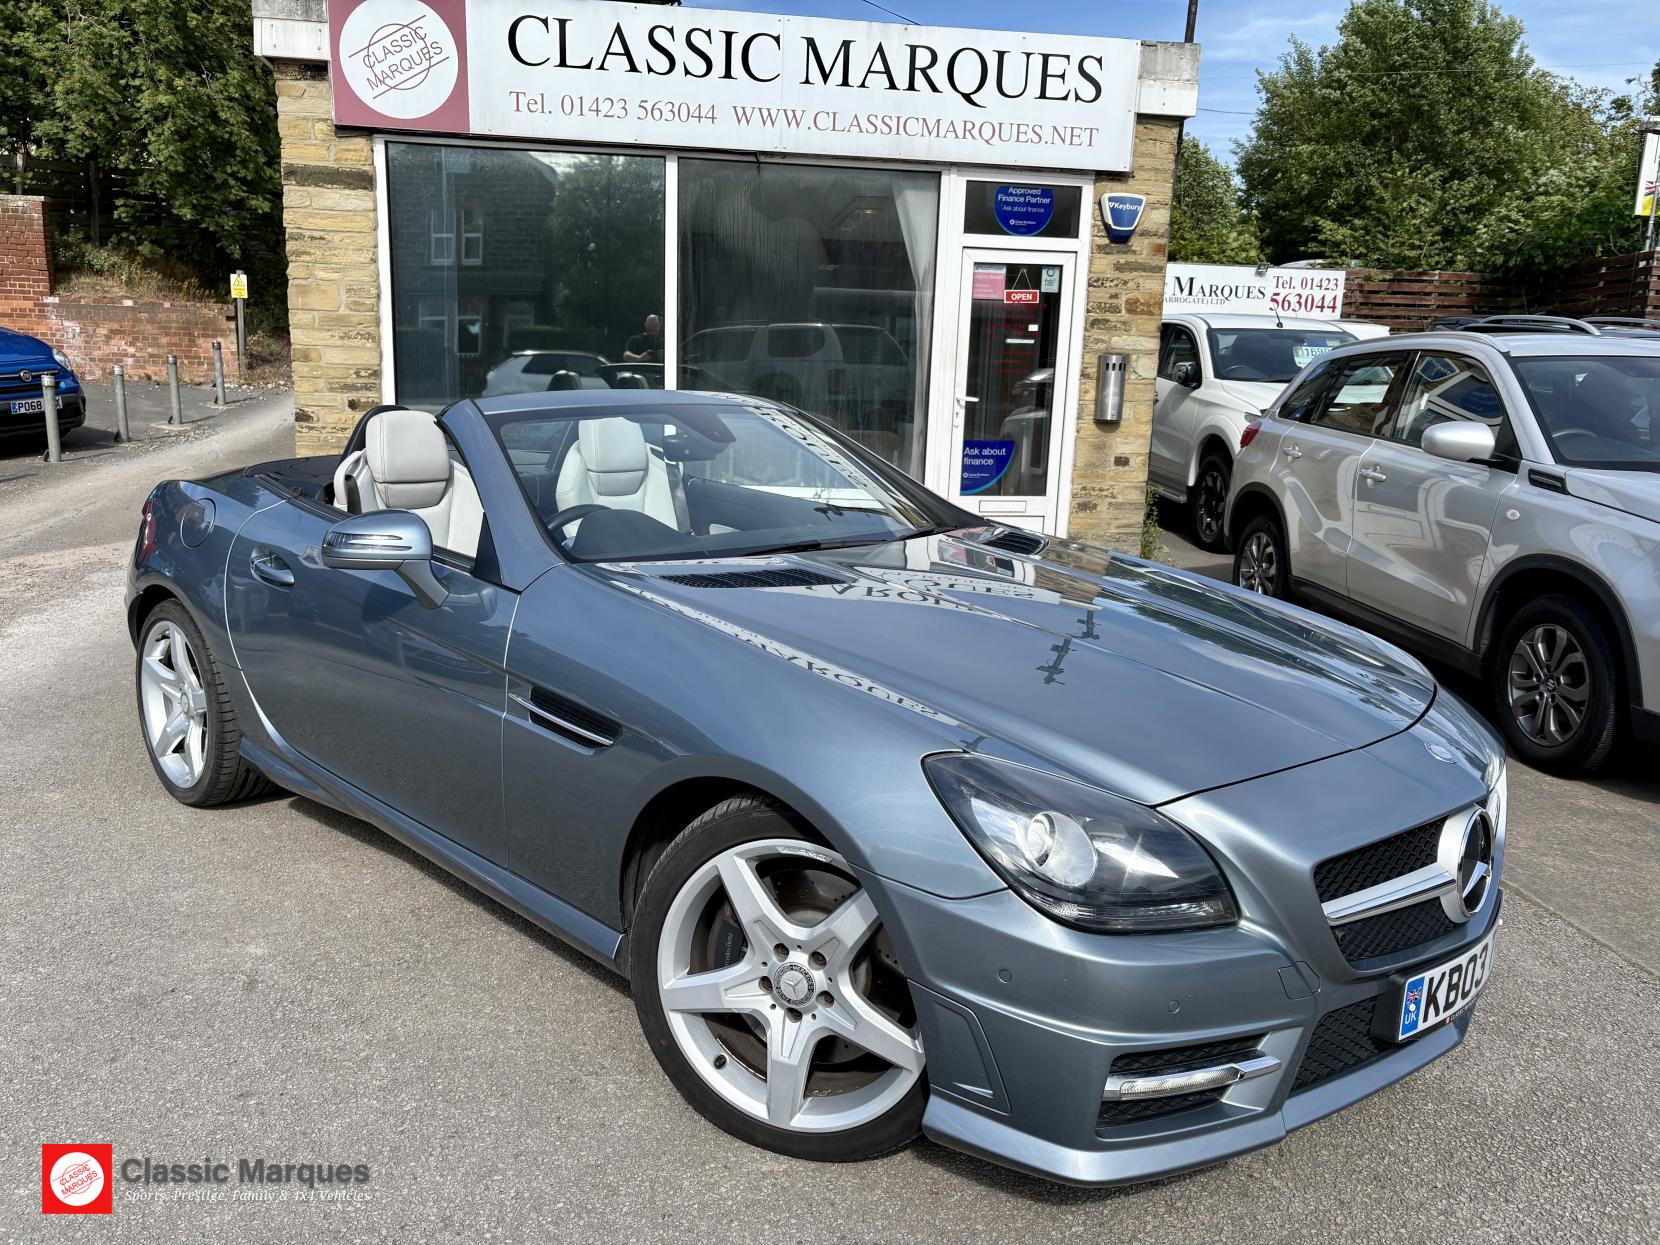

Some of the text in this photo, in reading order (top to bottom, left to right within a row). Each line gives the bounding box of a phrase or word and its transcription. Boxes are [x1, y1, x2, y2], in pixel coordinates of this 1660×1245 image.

[362, 26, 427, 68] CLASSIC
[366, 41, 443, 91] MARQUES
[507, 15, 1104, 108] CLASSIC MARQUES
[508, 91, 1100, 147] Tel. 01423 563044 WWW.CLASSICMARQUES.NET
[998, 194, 1051, 204] Finance Partner
[1008, 187, 1041, 195] Approved
[1114, 203, 1141, 211] Keybury
[1173, 276, 1266, 301] MARQUES
[1273, 275, 1339, 291] Tel. 01423
[1011, 293, 1033, 301] OPEN
[1269, 292, 1338, 313] 563044
[964, 447, 1006, 456] Ask about
[964, 456, 994, 465] finance
[1422, 942, 1489, 1024] KB03
[1404, 1011, 1417, 1025] UK
